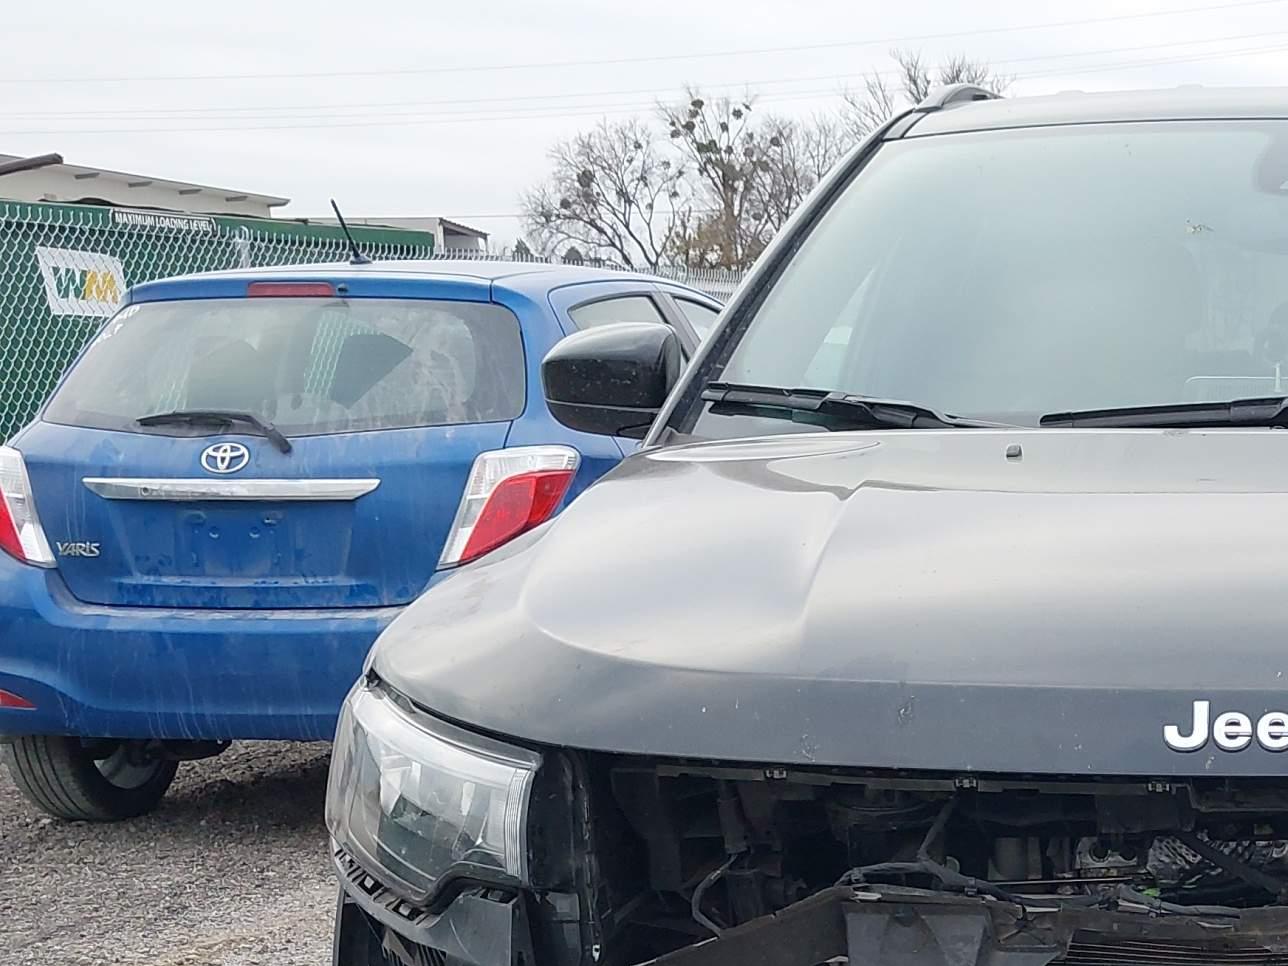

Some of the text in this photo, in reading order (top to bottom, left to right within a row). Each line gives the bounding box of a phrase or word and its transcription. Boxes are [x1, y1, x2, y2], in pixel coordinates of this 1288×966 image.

[114, 211, 212, 231] MAXIMUM LOADING LEVEL
[50, 265, 119, 304] WM
